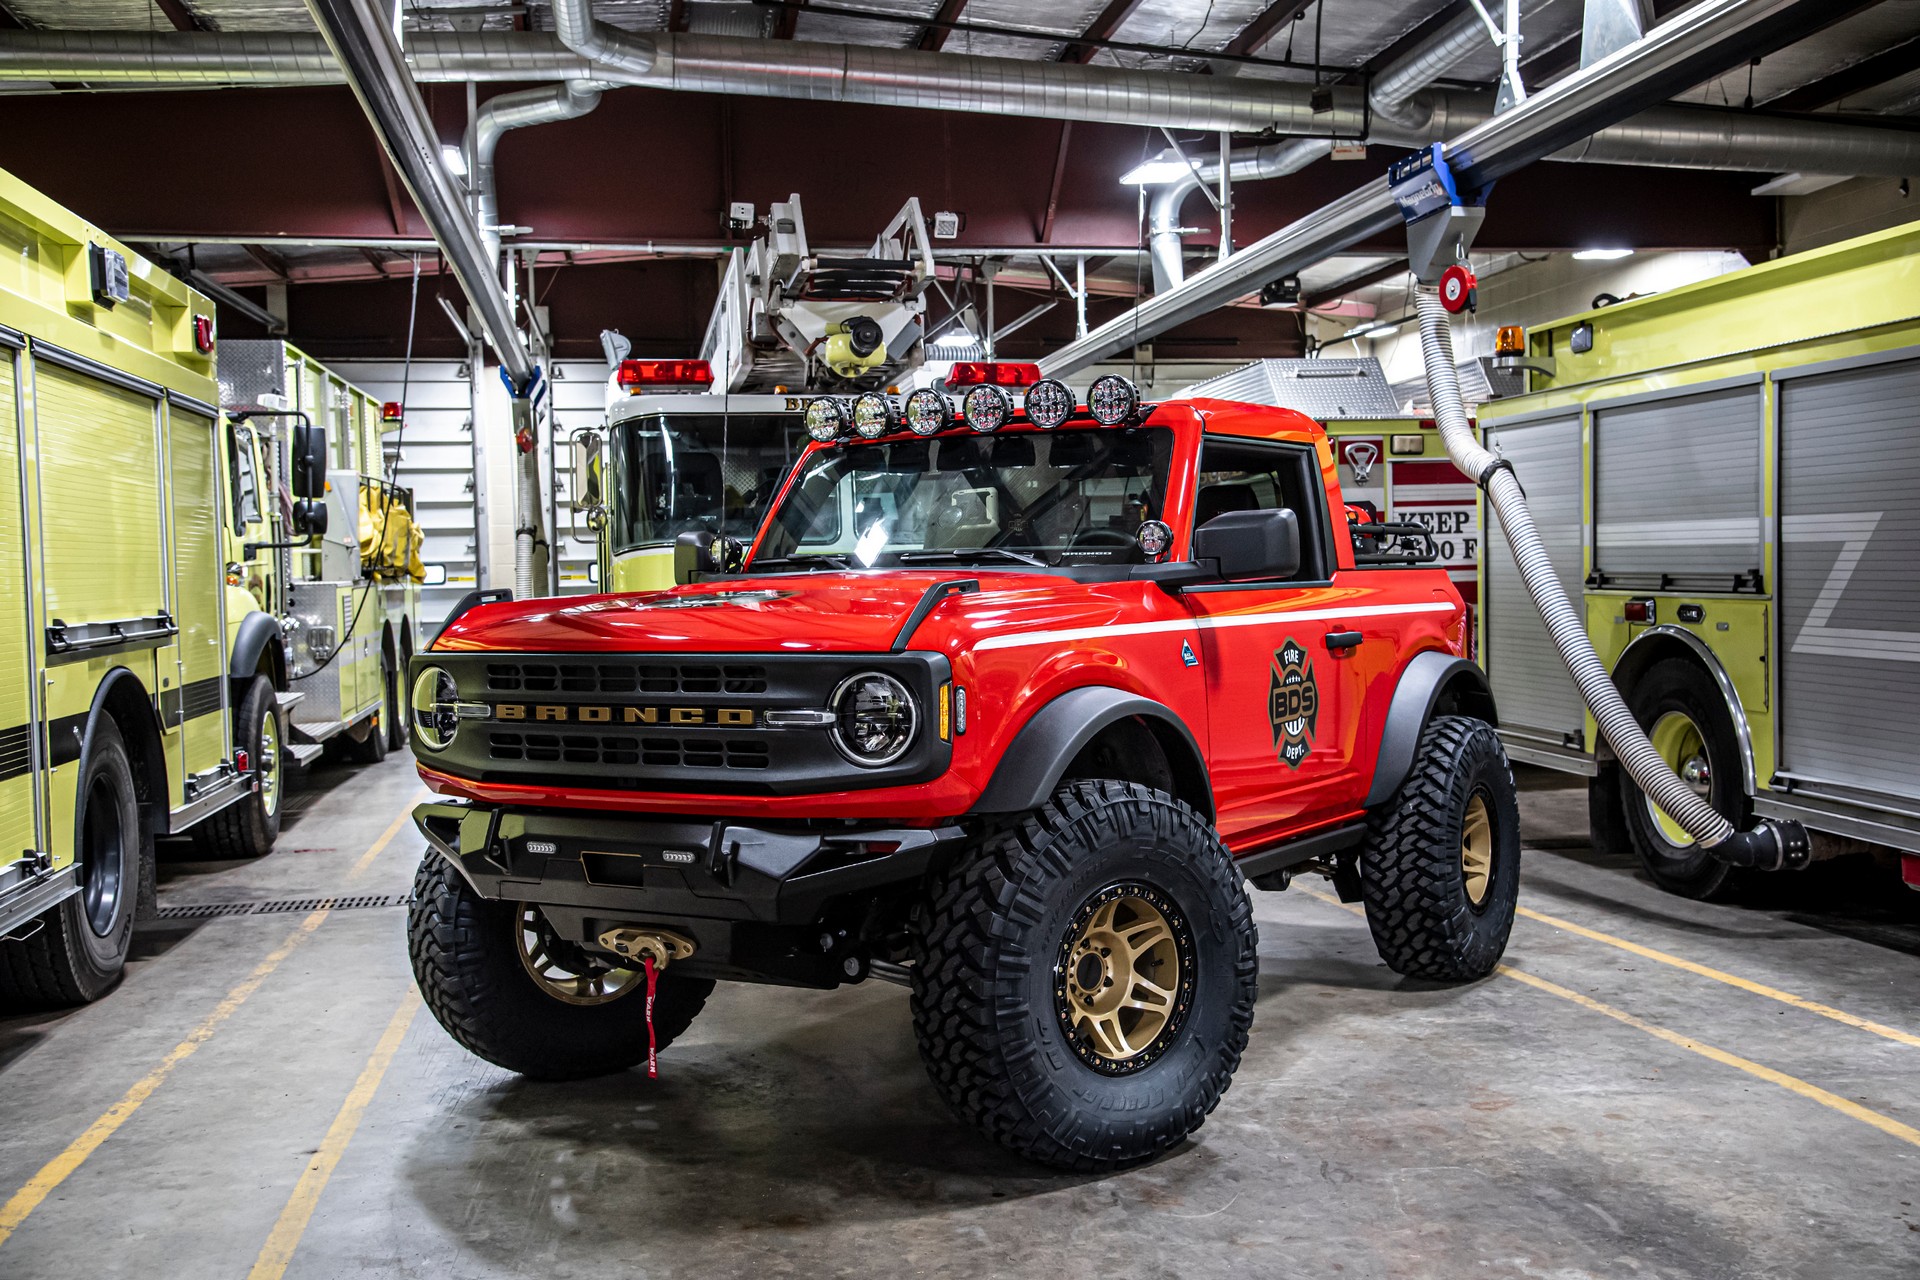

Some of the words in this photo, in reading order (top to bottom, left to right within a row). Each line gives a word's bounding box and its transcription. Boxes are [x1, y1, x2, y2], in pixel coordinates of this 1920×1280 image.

[1284, 649, 1299, 665] FIRE
[1274, 684, 1314, 721] BDS
[495, 704, 754, 725] BRONCO
